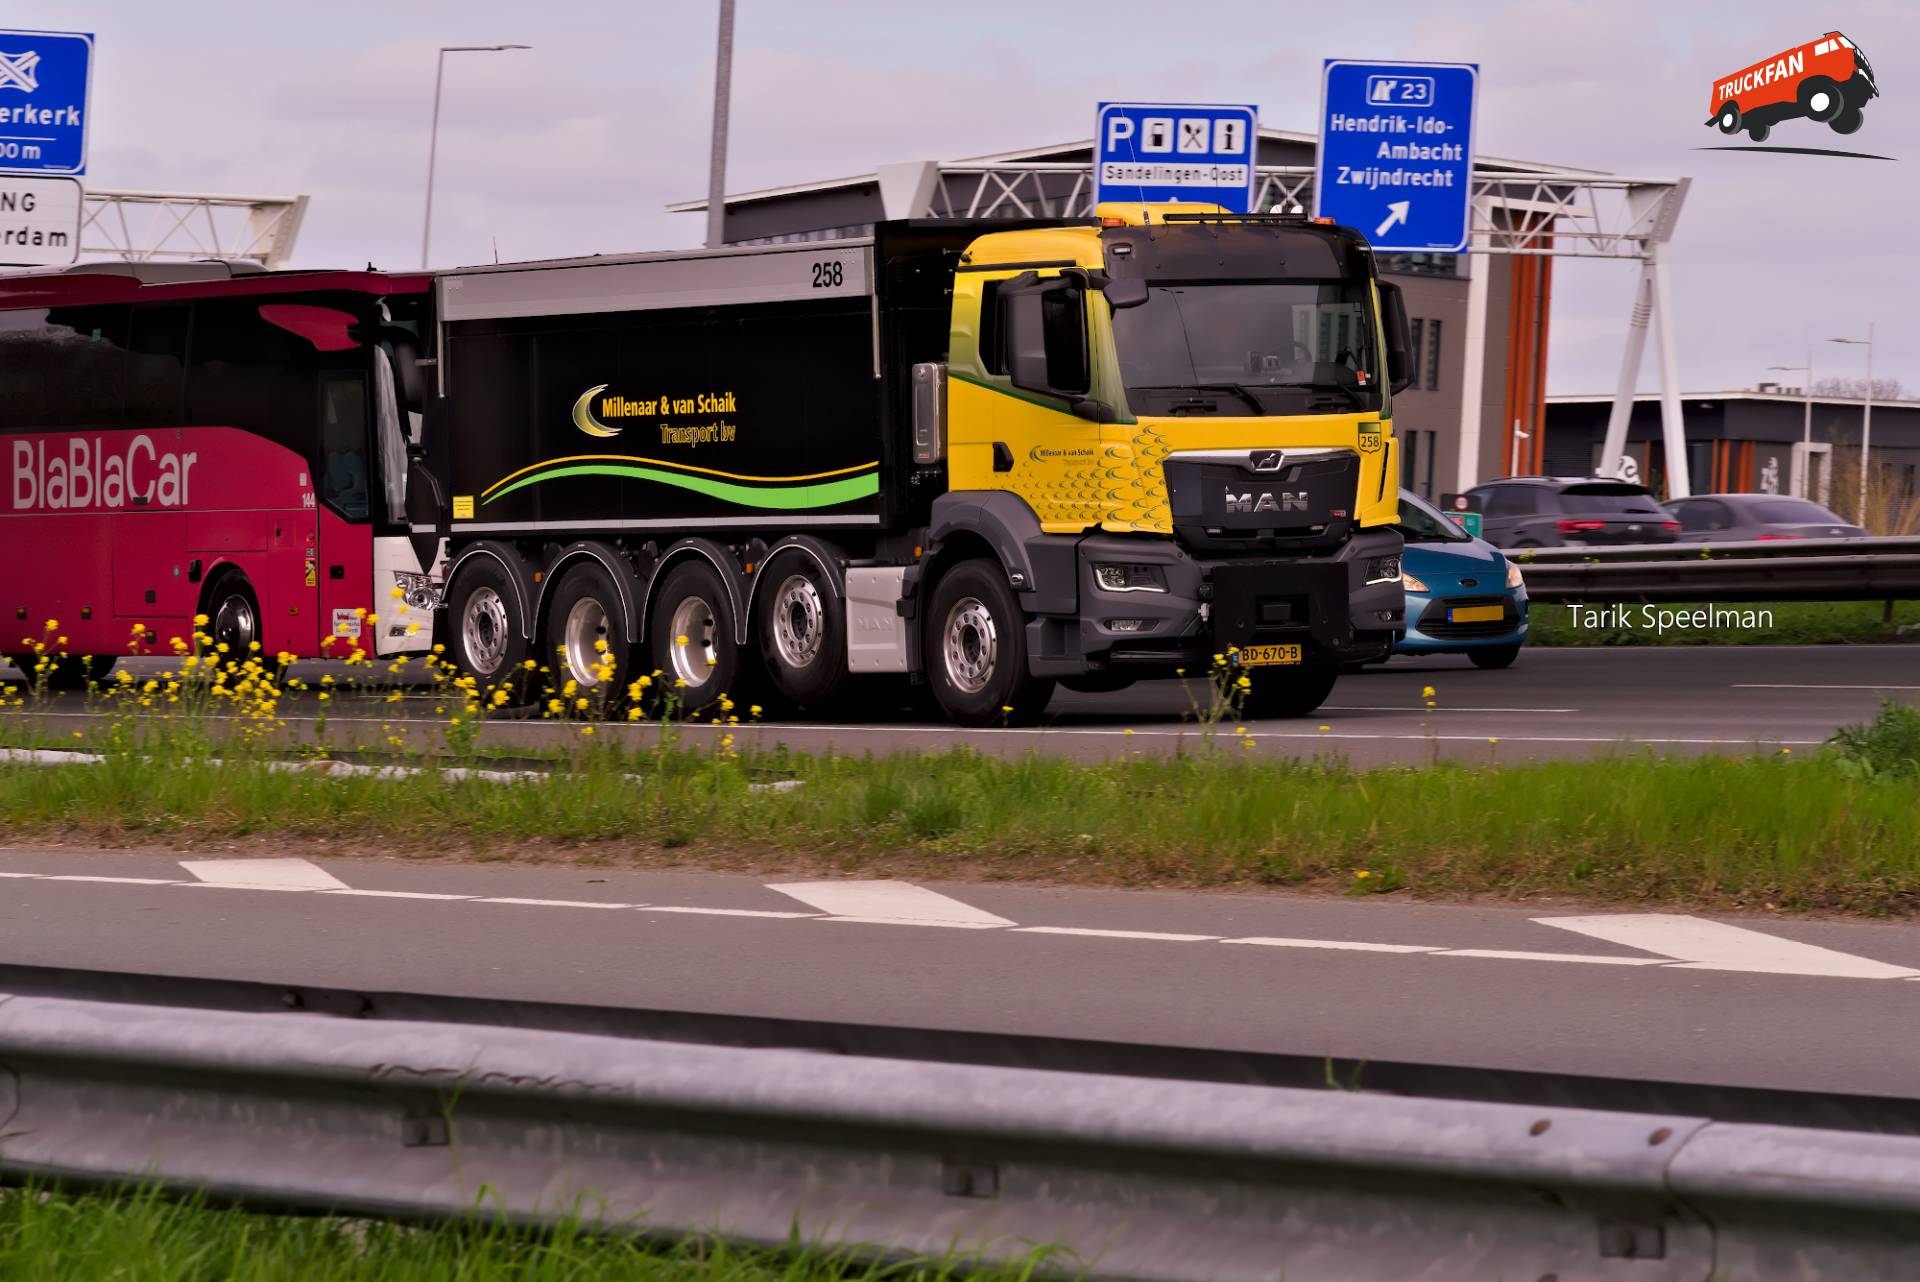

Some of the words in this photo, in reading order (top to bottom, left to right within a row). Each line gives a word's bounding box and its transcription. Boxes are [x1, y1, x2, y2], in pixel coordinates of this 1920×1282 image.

[1401, 83, 1427, 100] 23
[1331, 113, 1454, 134] Hendrik-Ido-
[1107, 117, 1135, 152] P
[22, 145, 41, 159] m
[1377, 141, 1463, 160] Ambacht
[1105, 165, 1244, 184] Sandelingen-Oost
[1336, 166, 1453, 190] Zwijndrecht
[0, 226, 68, 247] rdam
[812, 261, 843, 287] 258
[602, 396, 657, 417] Millenaar
[660, 395, 669, 415] &
[673, 400, 694, 414] van
[698, 392, 736, 413] Schaik
[660, 421, 718, 448] Transport
[721, 420, 736, 442] bv
[1361, 436, 1380, 448] 258
[13, 435, 197, 509] BlaBlaCar
[1226, 491, 1308, 513] MAN
[1242, 646, 1298, 661] BD-670-B
